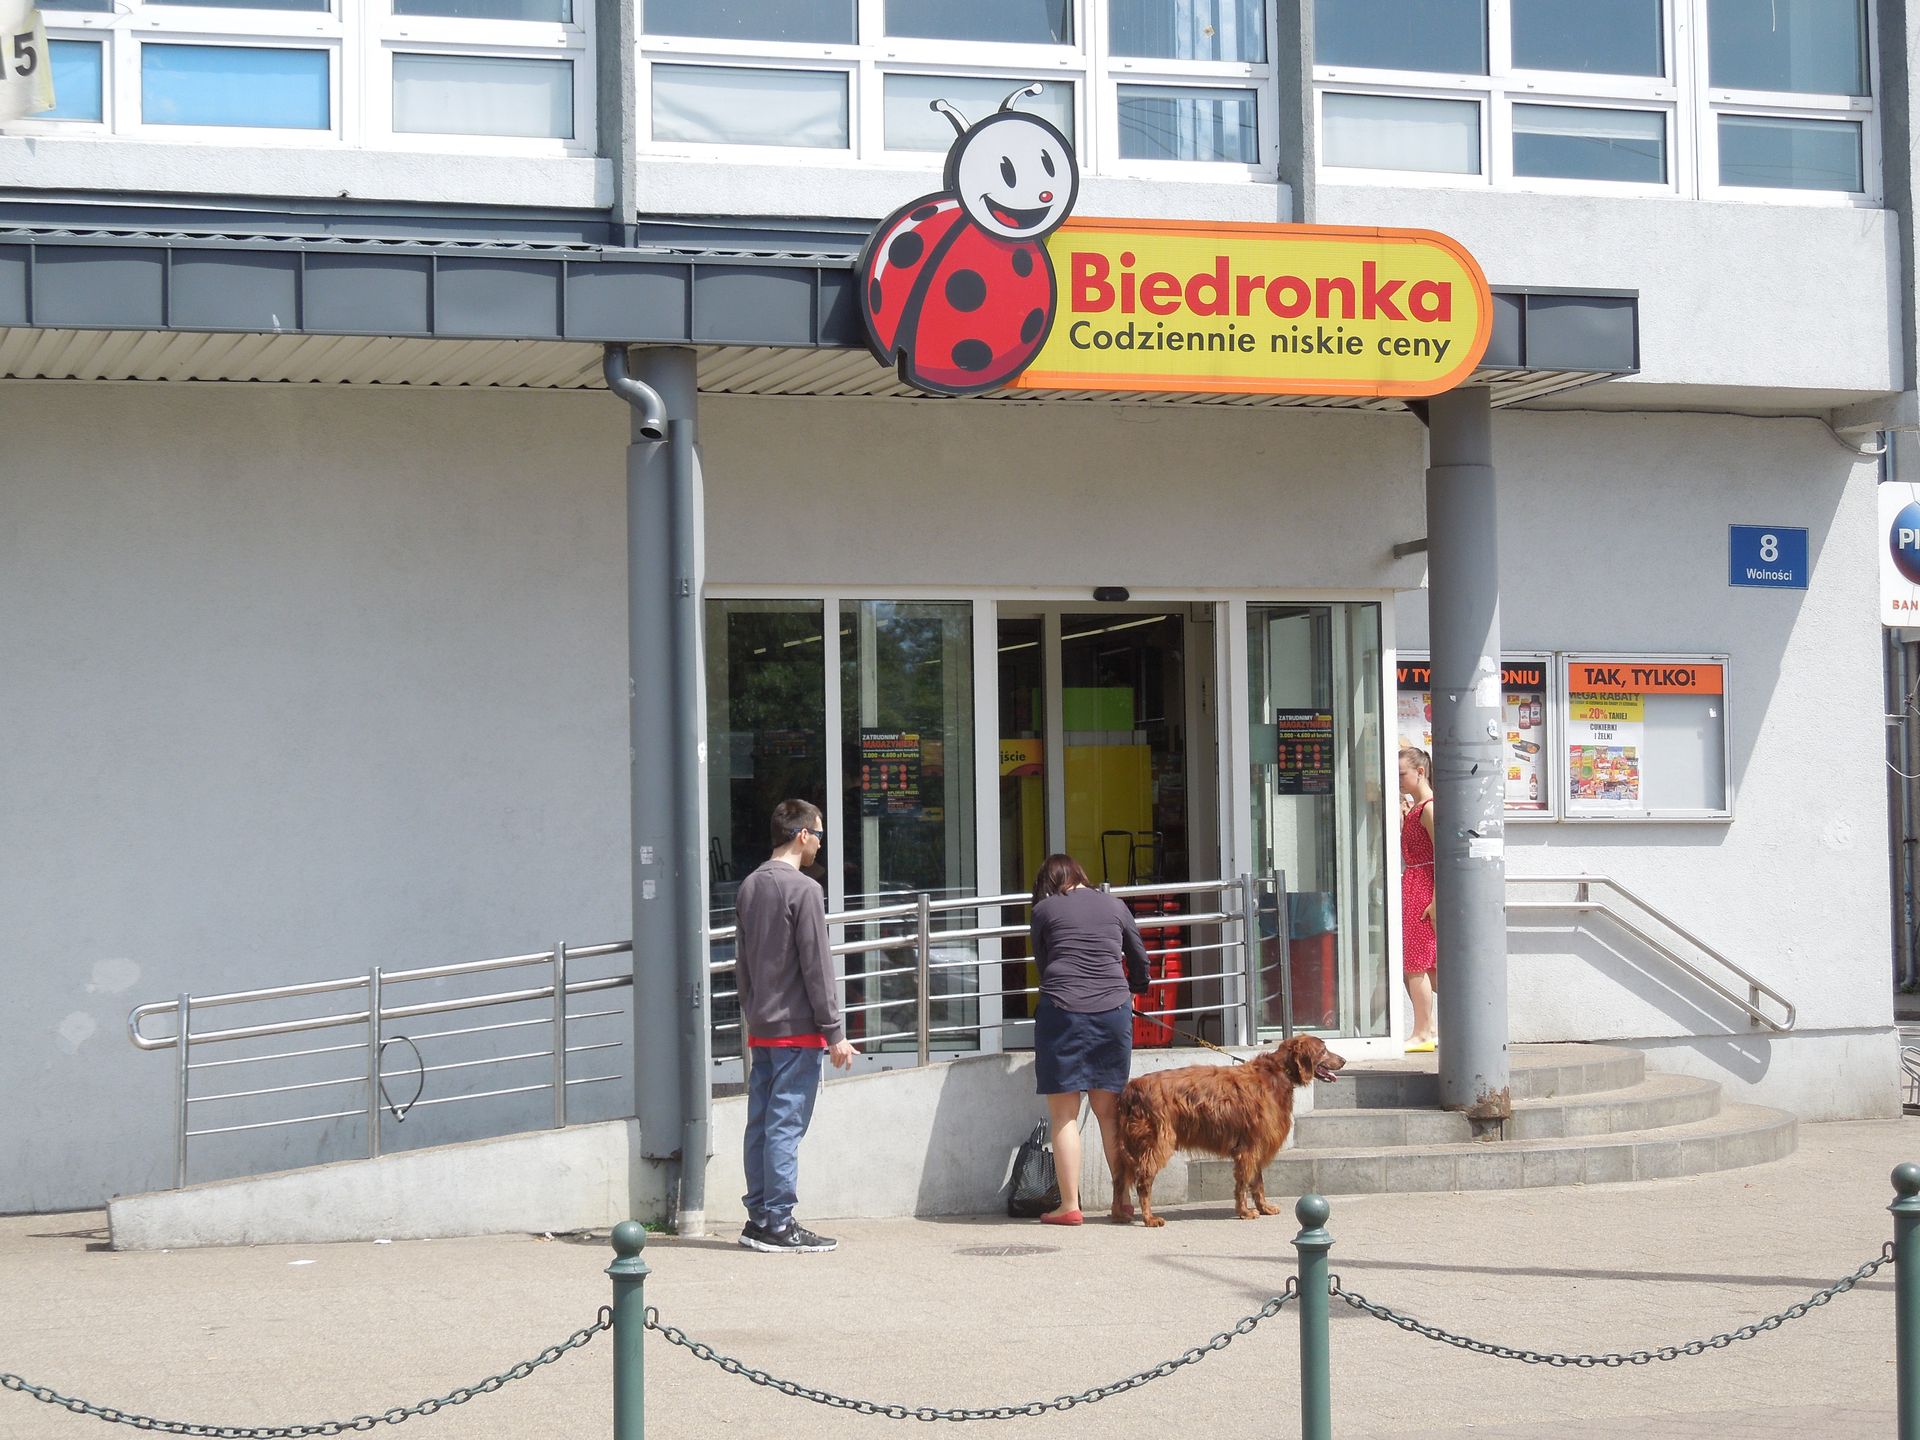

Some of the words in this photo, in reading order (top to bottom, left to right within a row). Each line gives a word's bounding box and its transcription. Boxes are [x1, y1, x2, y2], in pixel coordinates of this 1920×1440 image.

[1070, 251, 1452, 322] Biedronka
[1069, 320, 1256, 353] Codziennie
[1271, 325, 1363, 355] niskie
[1377, 337, 1451, 363] ceny
[1759, 534, 1779, 563] 8
[1746, 568, 1792, 581] Wolności
[1584, 668, 1626, 688] TAK,
[1631, 669, 1696, 687] TYLKO!
[1600, 692, 1641, 701] RABATY
[1588, 707, 1608, 720] 20%
[1609, 712, 1627, 720] TANIEJ
[1279, 721, 1332, 729] MAGAZYNIERA
[1589, 723, 1617, 731] CUKIERKI
[1597, 732, 1613, 740] ŻELKI
[863, 740, 920, 749] MAGAZYNIERA
